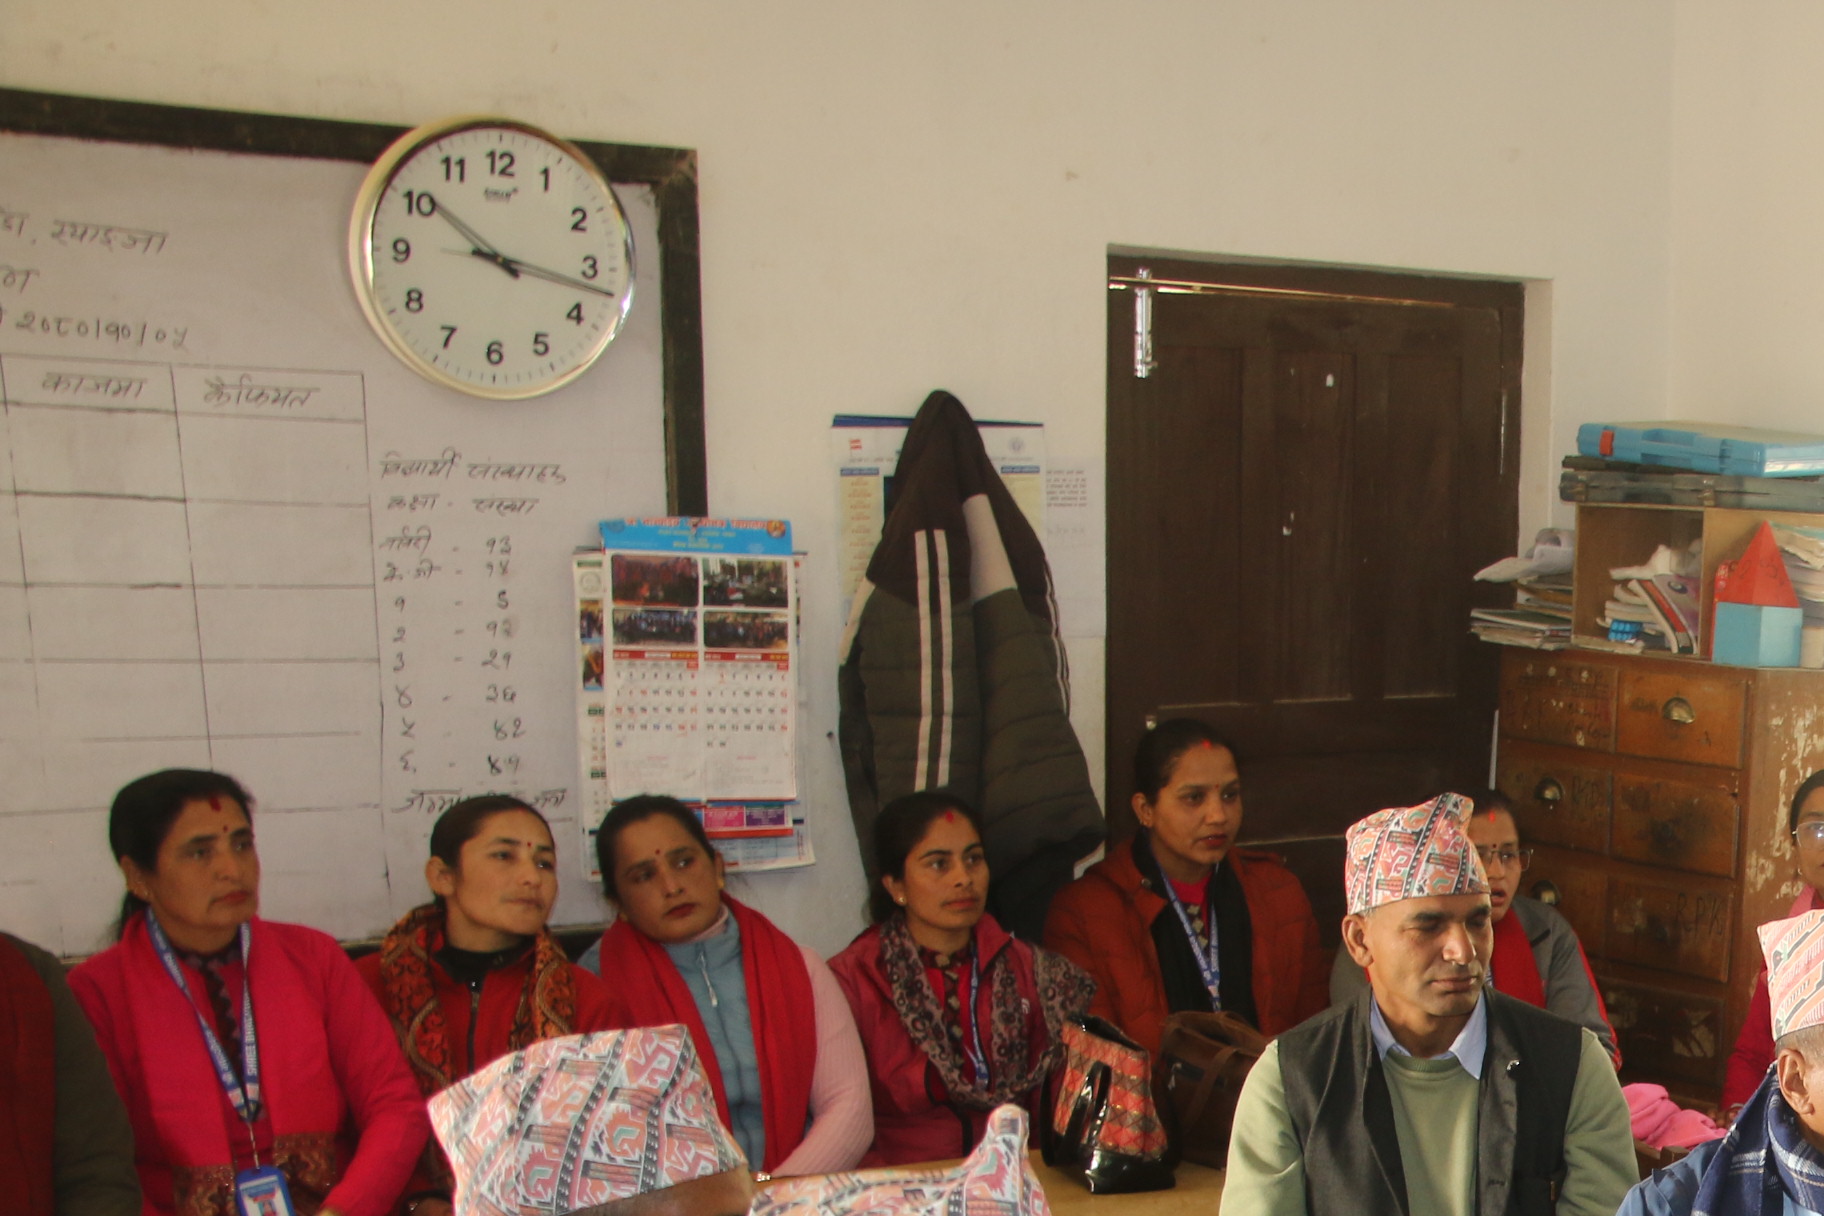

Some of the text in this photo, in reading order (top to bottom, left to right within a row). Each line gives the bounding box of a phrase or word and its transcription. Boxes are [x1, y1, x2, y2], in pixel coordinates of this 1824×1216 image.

[441, 157, 466, 182] 11
[486, 150, 515, 176] 12
[540, 167, 550, 191] 1
[403, 190, 437, 216] 10
[571, 207, 587, 232] 2
[392, 238, 411, 263] 9
[581, 256, 598, 279] 3
[405, 288, 423, 312] 8
[567, 303, 584, 325] 4
[440, 325, 457, 348] 7
[533, 333, 549, 355] 5
[486, 341, 504, 364] 6
